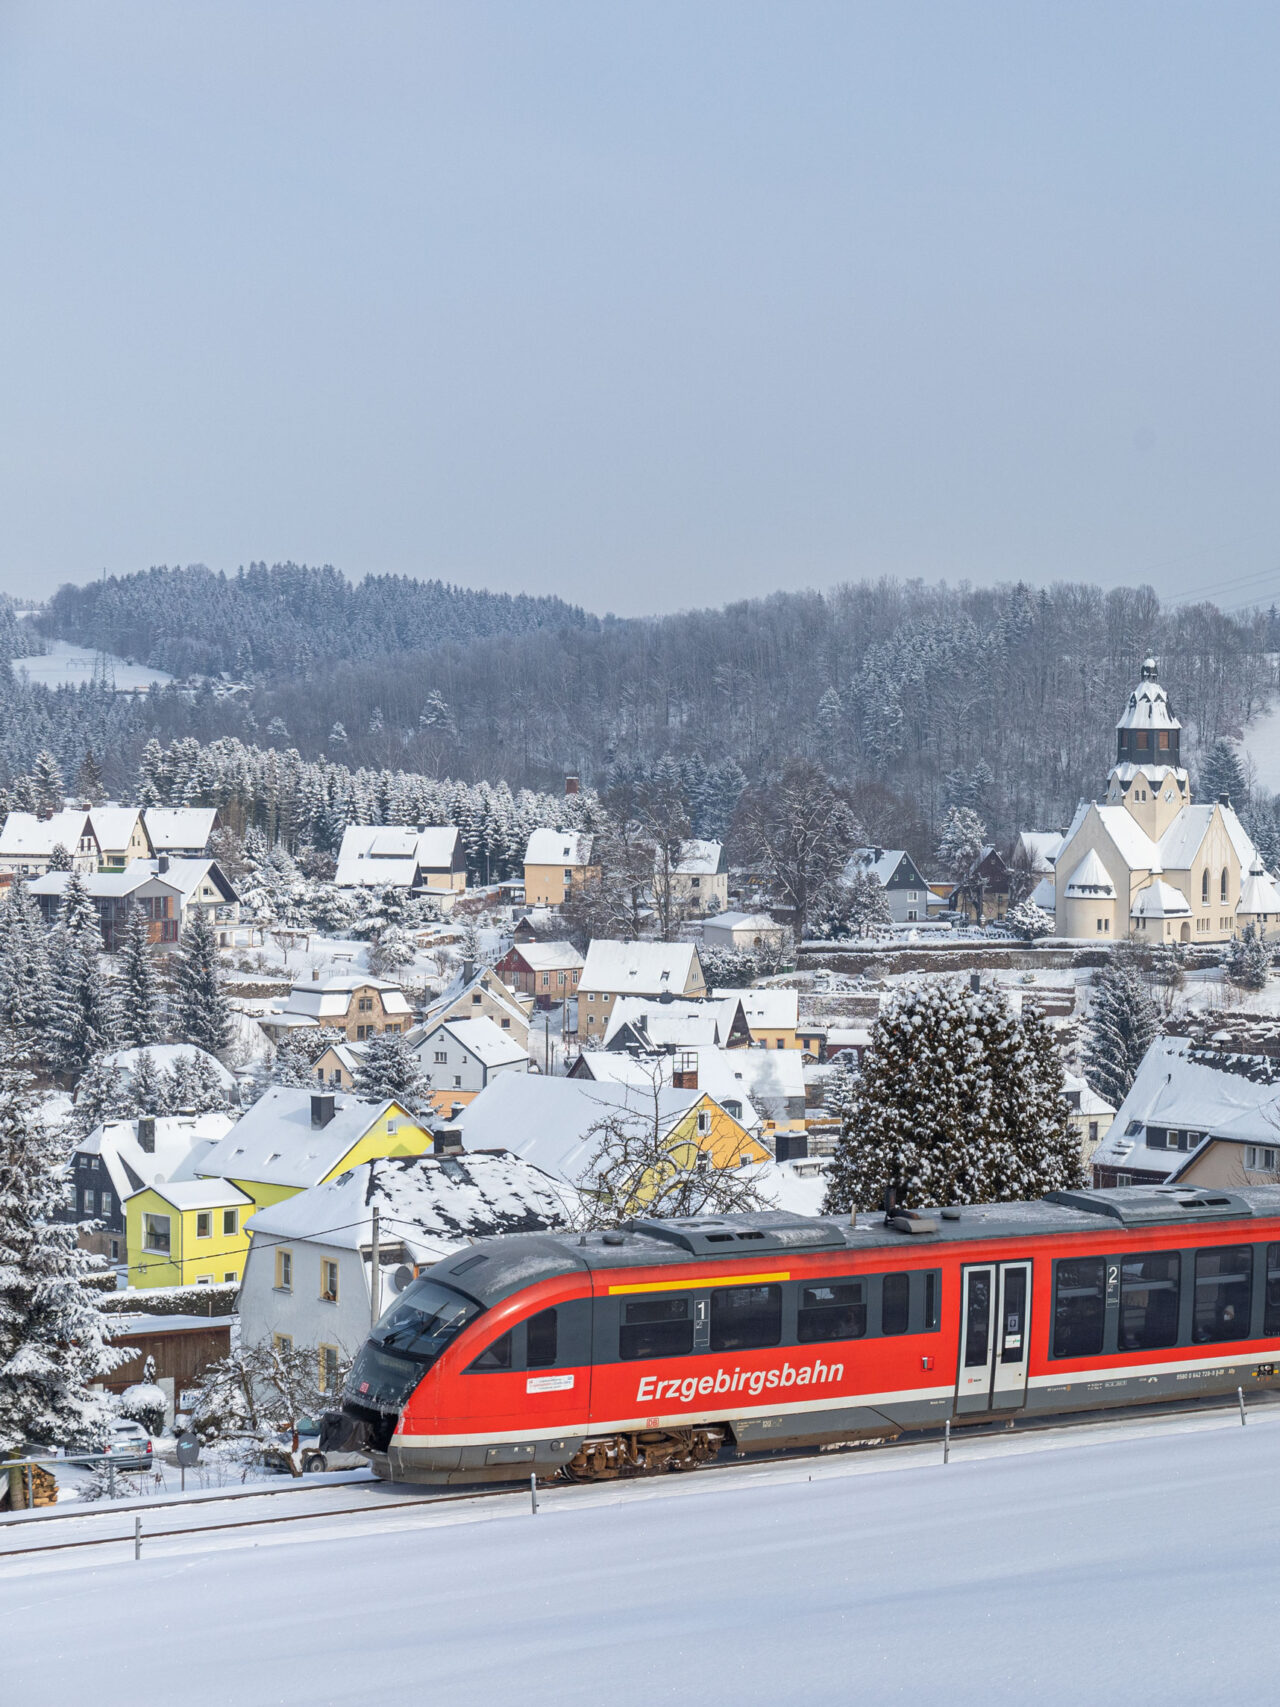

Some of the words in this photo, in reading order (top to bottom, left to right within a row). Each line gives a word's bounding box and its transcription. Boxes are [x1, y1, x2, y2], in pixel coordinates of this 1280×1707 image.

[1109, 1266, 1118, 1284] 2
[697, 1301, 705, 1320] 1
[636, 1360, 844, 1402] Erzgebirgsbahn
[646, 1417, 660, 1428] DB
